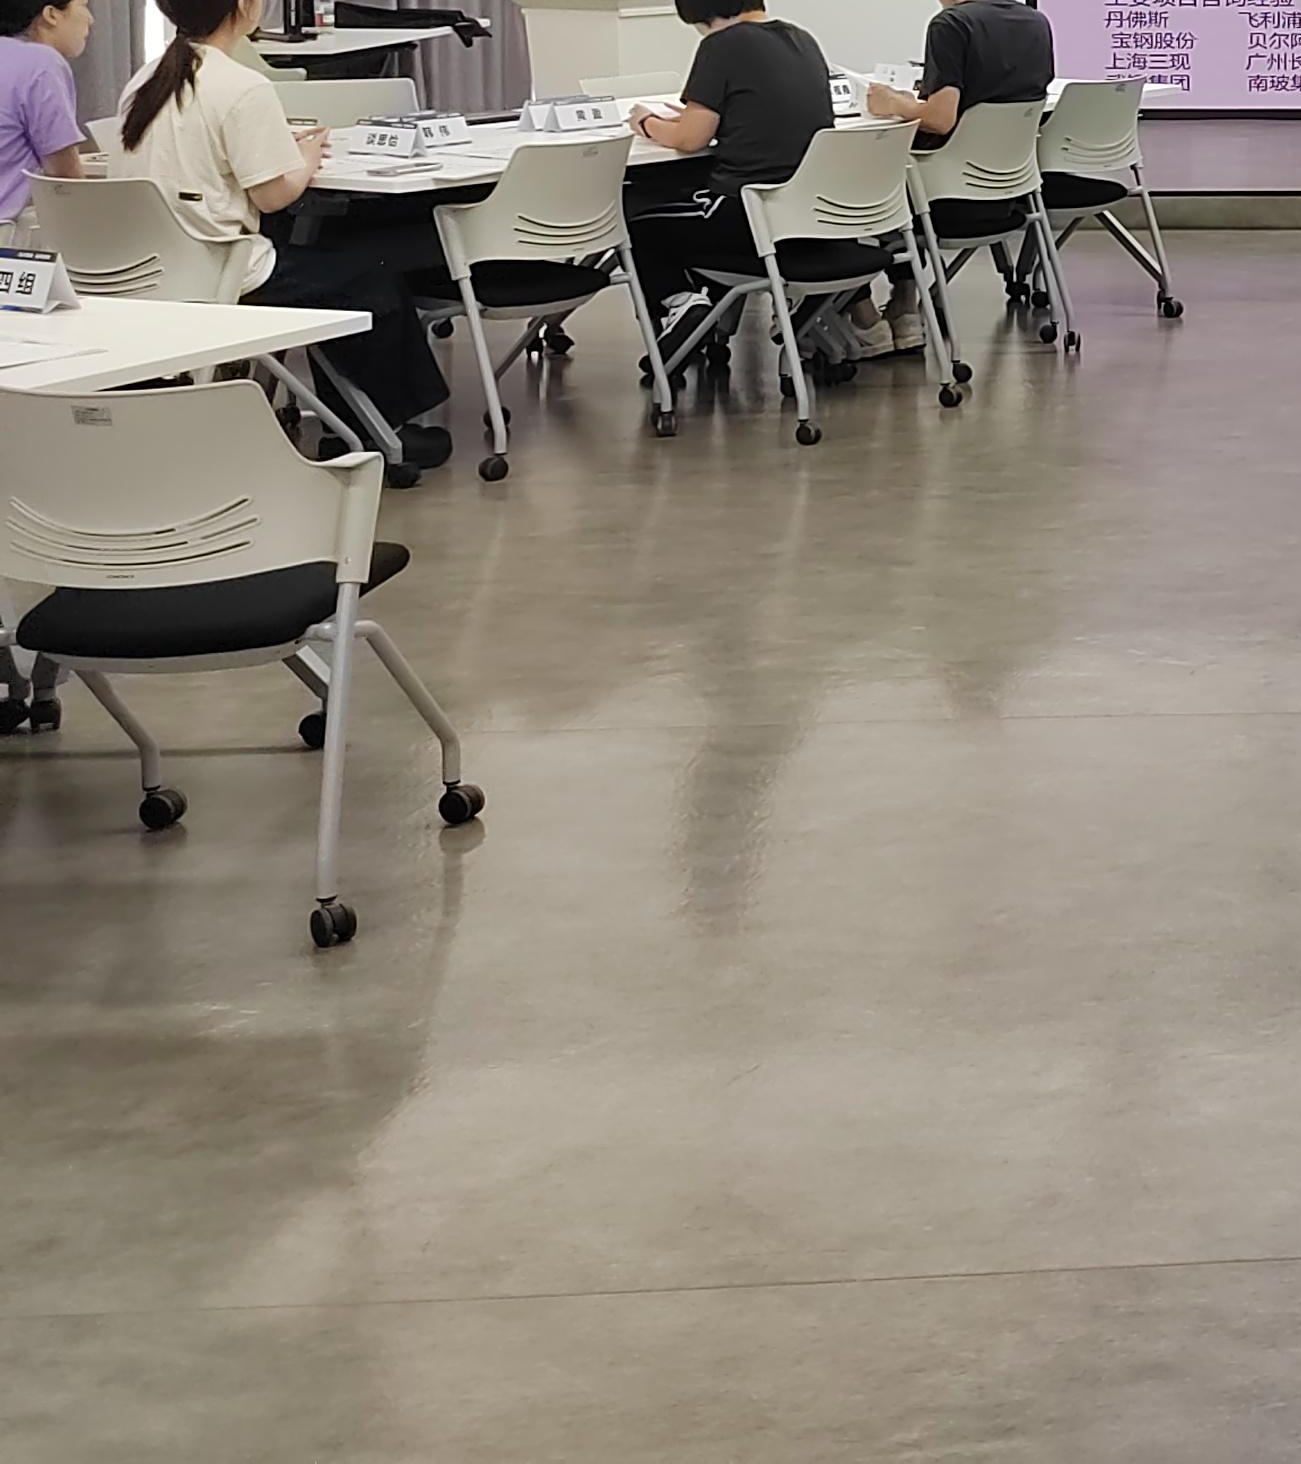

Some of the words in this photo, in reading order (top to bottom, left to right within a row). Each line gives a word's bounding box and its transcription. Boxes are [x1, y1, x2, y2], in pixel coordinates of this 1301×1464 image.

[1104, 11, 1169, 29] 丹佛斯
[1112, 32, 1196, 50] 宝钢股份
